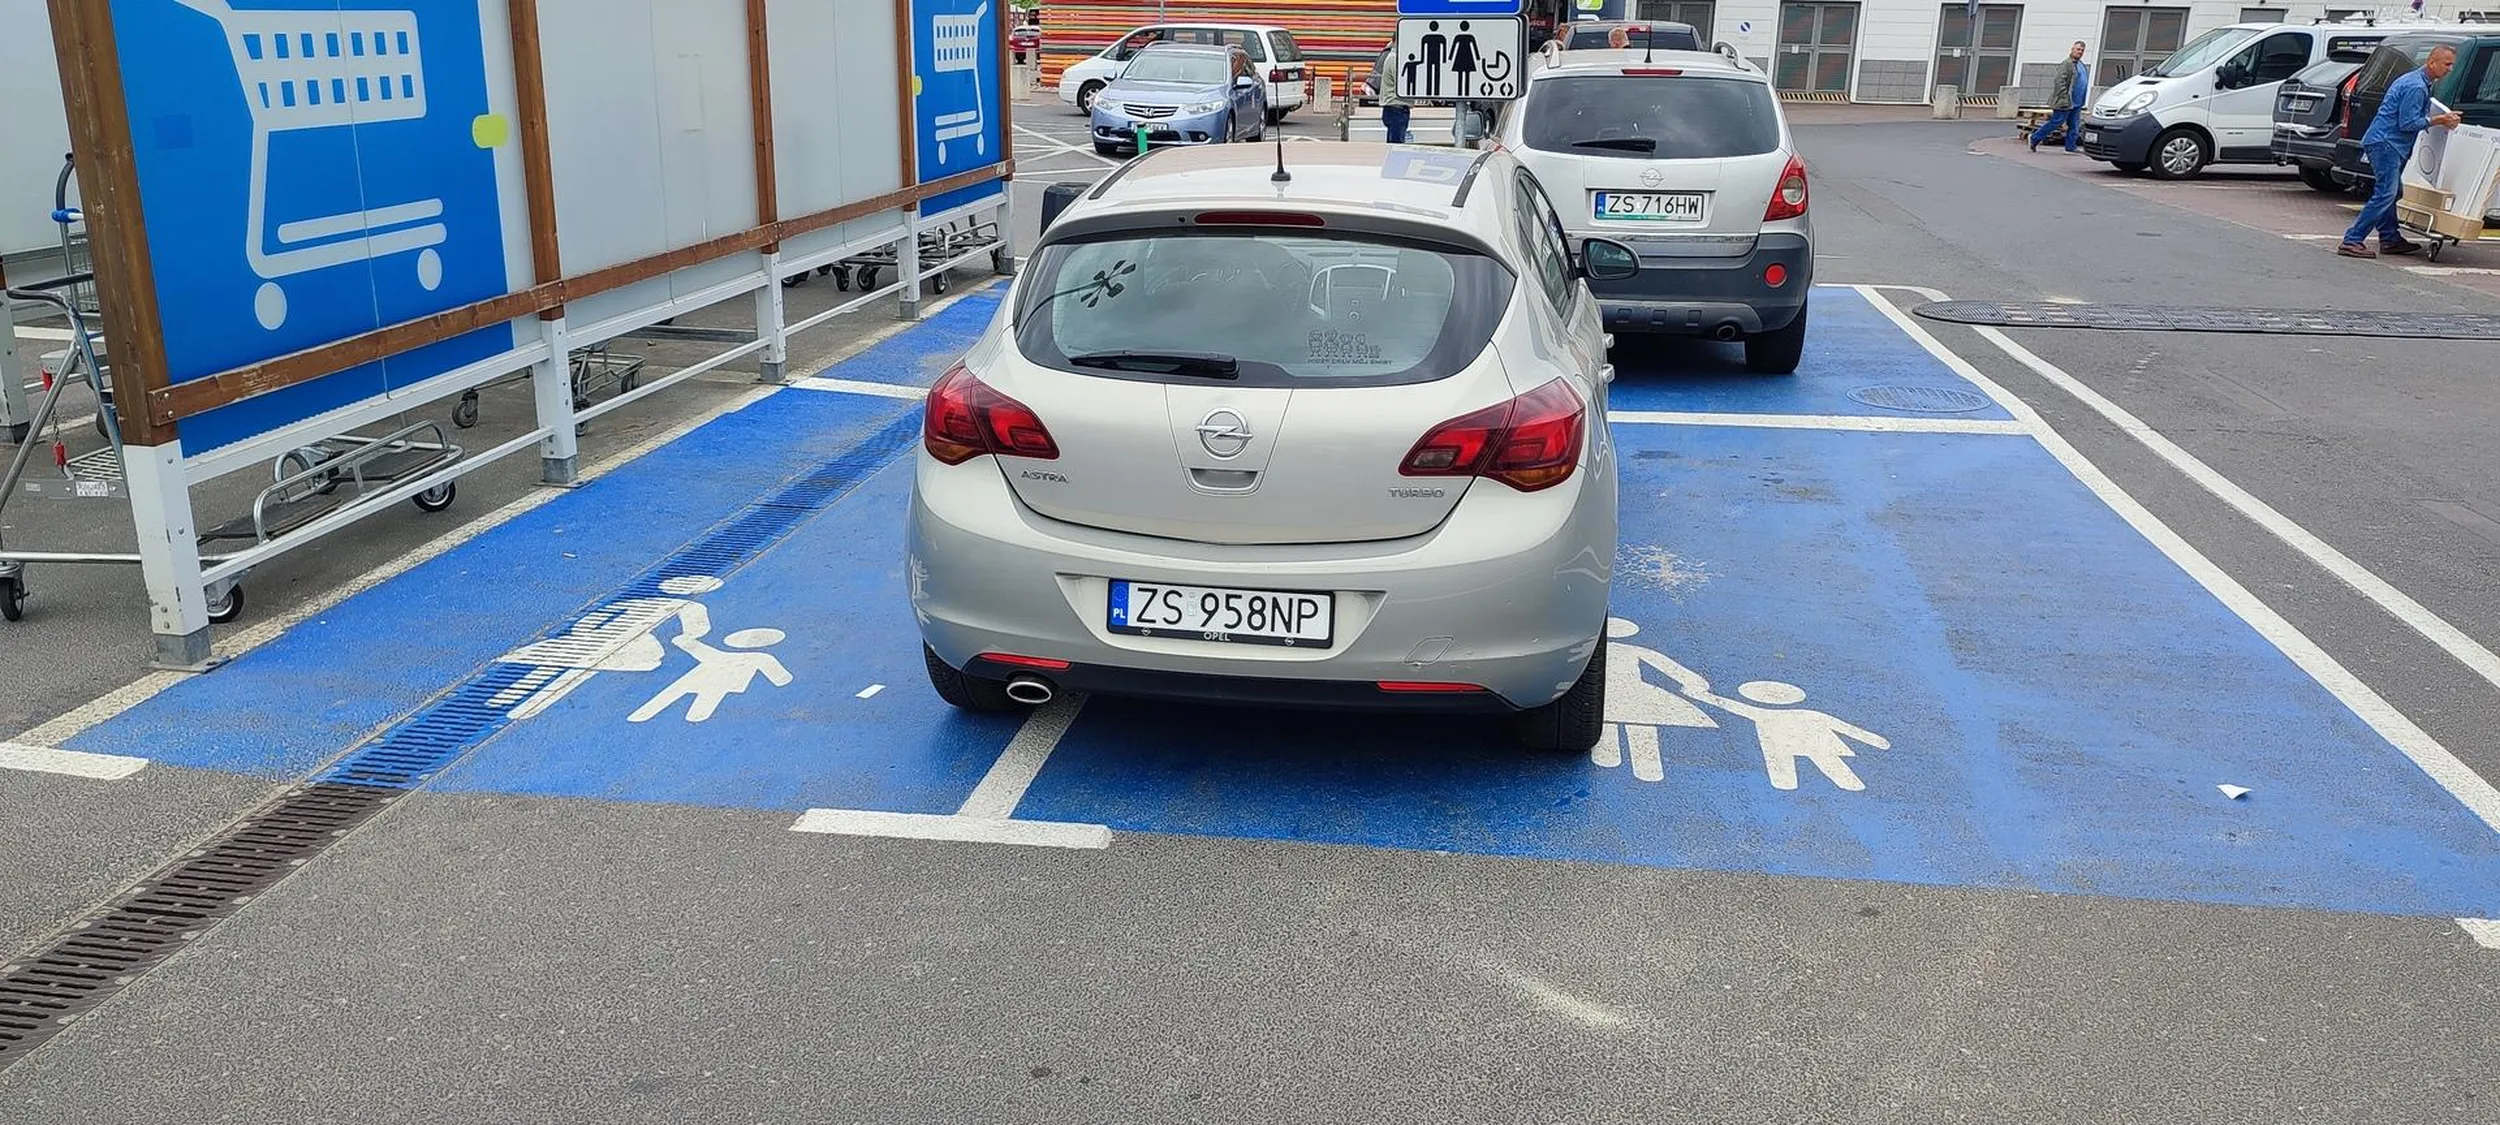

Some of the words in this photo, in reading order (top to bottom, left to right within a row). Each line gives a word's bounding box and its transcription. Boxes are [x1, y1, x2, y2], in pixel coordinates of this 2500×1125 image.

[1608, 195, 1635, 213] ZS
[1642, 195, 1699, 214] 716HW
[1021, 469, 1069, 482] ASTRA
[1388, 487, 1445, 498] TURBO
[1113, 607, 1126, 619] PL
[1136, 587, 1183, 625] ZS
[1200, 593, 1319, 634] 958NP
[1203, 631, 1230, 642] OPEL
